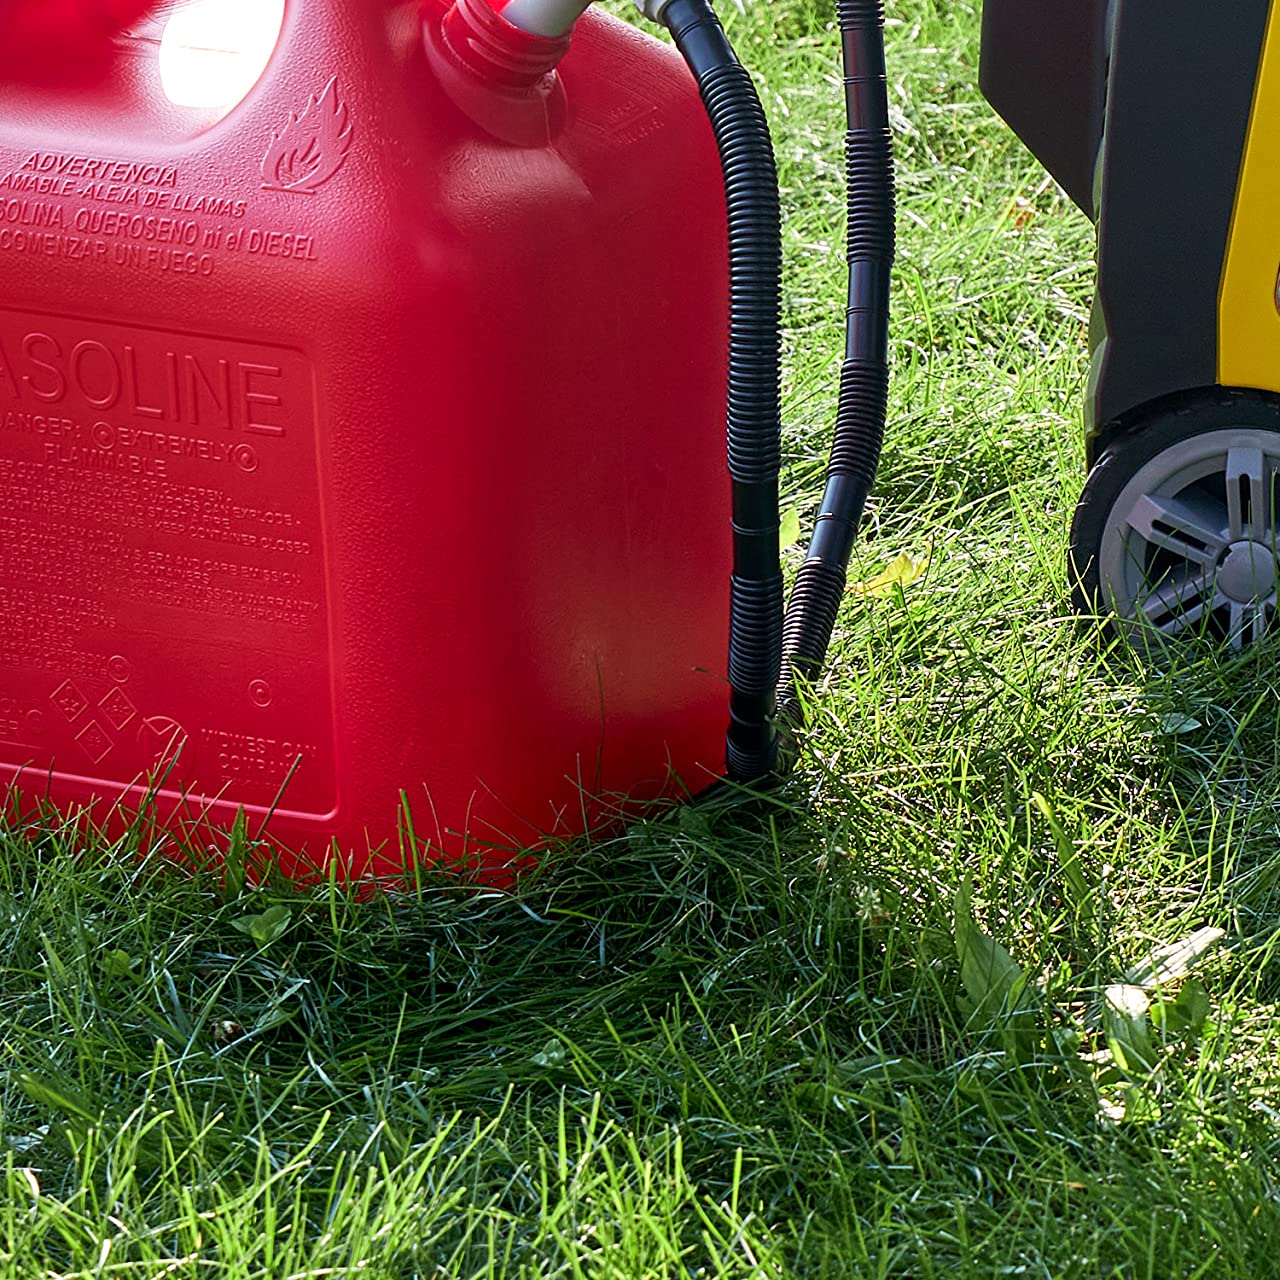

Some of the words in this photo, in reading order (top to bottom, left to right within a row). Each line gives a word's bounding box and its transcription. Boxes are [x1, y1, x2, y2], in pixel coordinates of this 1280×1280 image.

[20, 152, 178, 188] ADVERTENCIA
[143, 188, 170, 210] DE
[172, 194, 248, 219] LLAMAS
[0, 228, 107, 259] COMENZAR
[115, 242, 142, 267] UN
[147, 247, 215, 276] FUEGO
[75, 207, 199, 247] QUEROSENO
[203, 224, 222, 250] ni
[225, 228, 244, 252] el
[248, 228, 319, 261] DIESEL
[0, 410, 80, 437] ANGER:
[117, 427, 232, 461] EXTREMELY
[43, 442, 167, 478] FLAMMABLE
[261, 535, 311, 555] CLOSED
